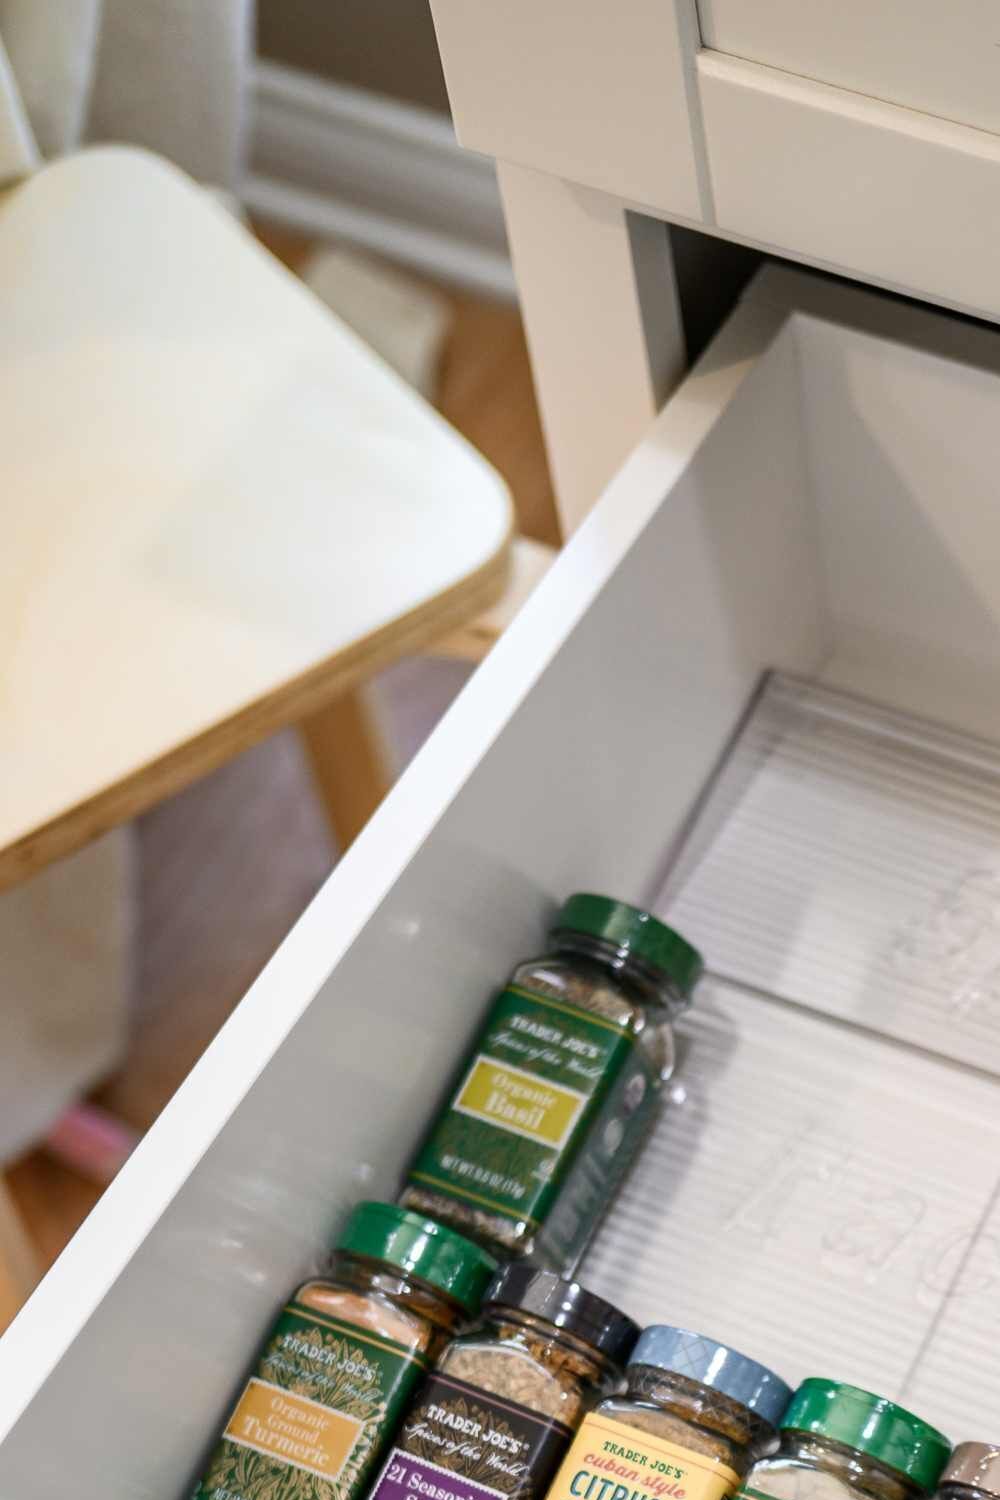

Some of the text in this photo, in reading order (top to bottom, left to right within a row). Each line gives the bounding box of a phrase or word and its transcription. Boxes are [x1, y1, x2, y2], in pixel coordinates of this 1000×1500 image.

[492, 1074, 558, 1105] Organic
[485, 1092, 545, 1129] Basil
[282, 1335, 374, 1381] TRADER JOE'S
[267, 1412, 320, 1443] Ground
[271, 1397, 329, 1430] Organic
[426, 1404, 522, 1454] TRADER JOE'S
[243, 1416, 330, 1467] Turmeric
[603, 1441, 683, 1479] TRADER JOE'S
[386, 1463, 404, 1484] 21
[584, 1453, 686, 1500] cuban style
